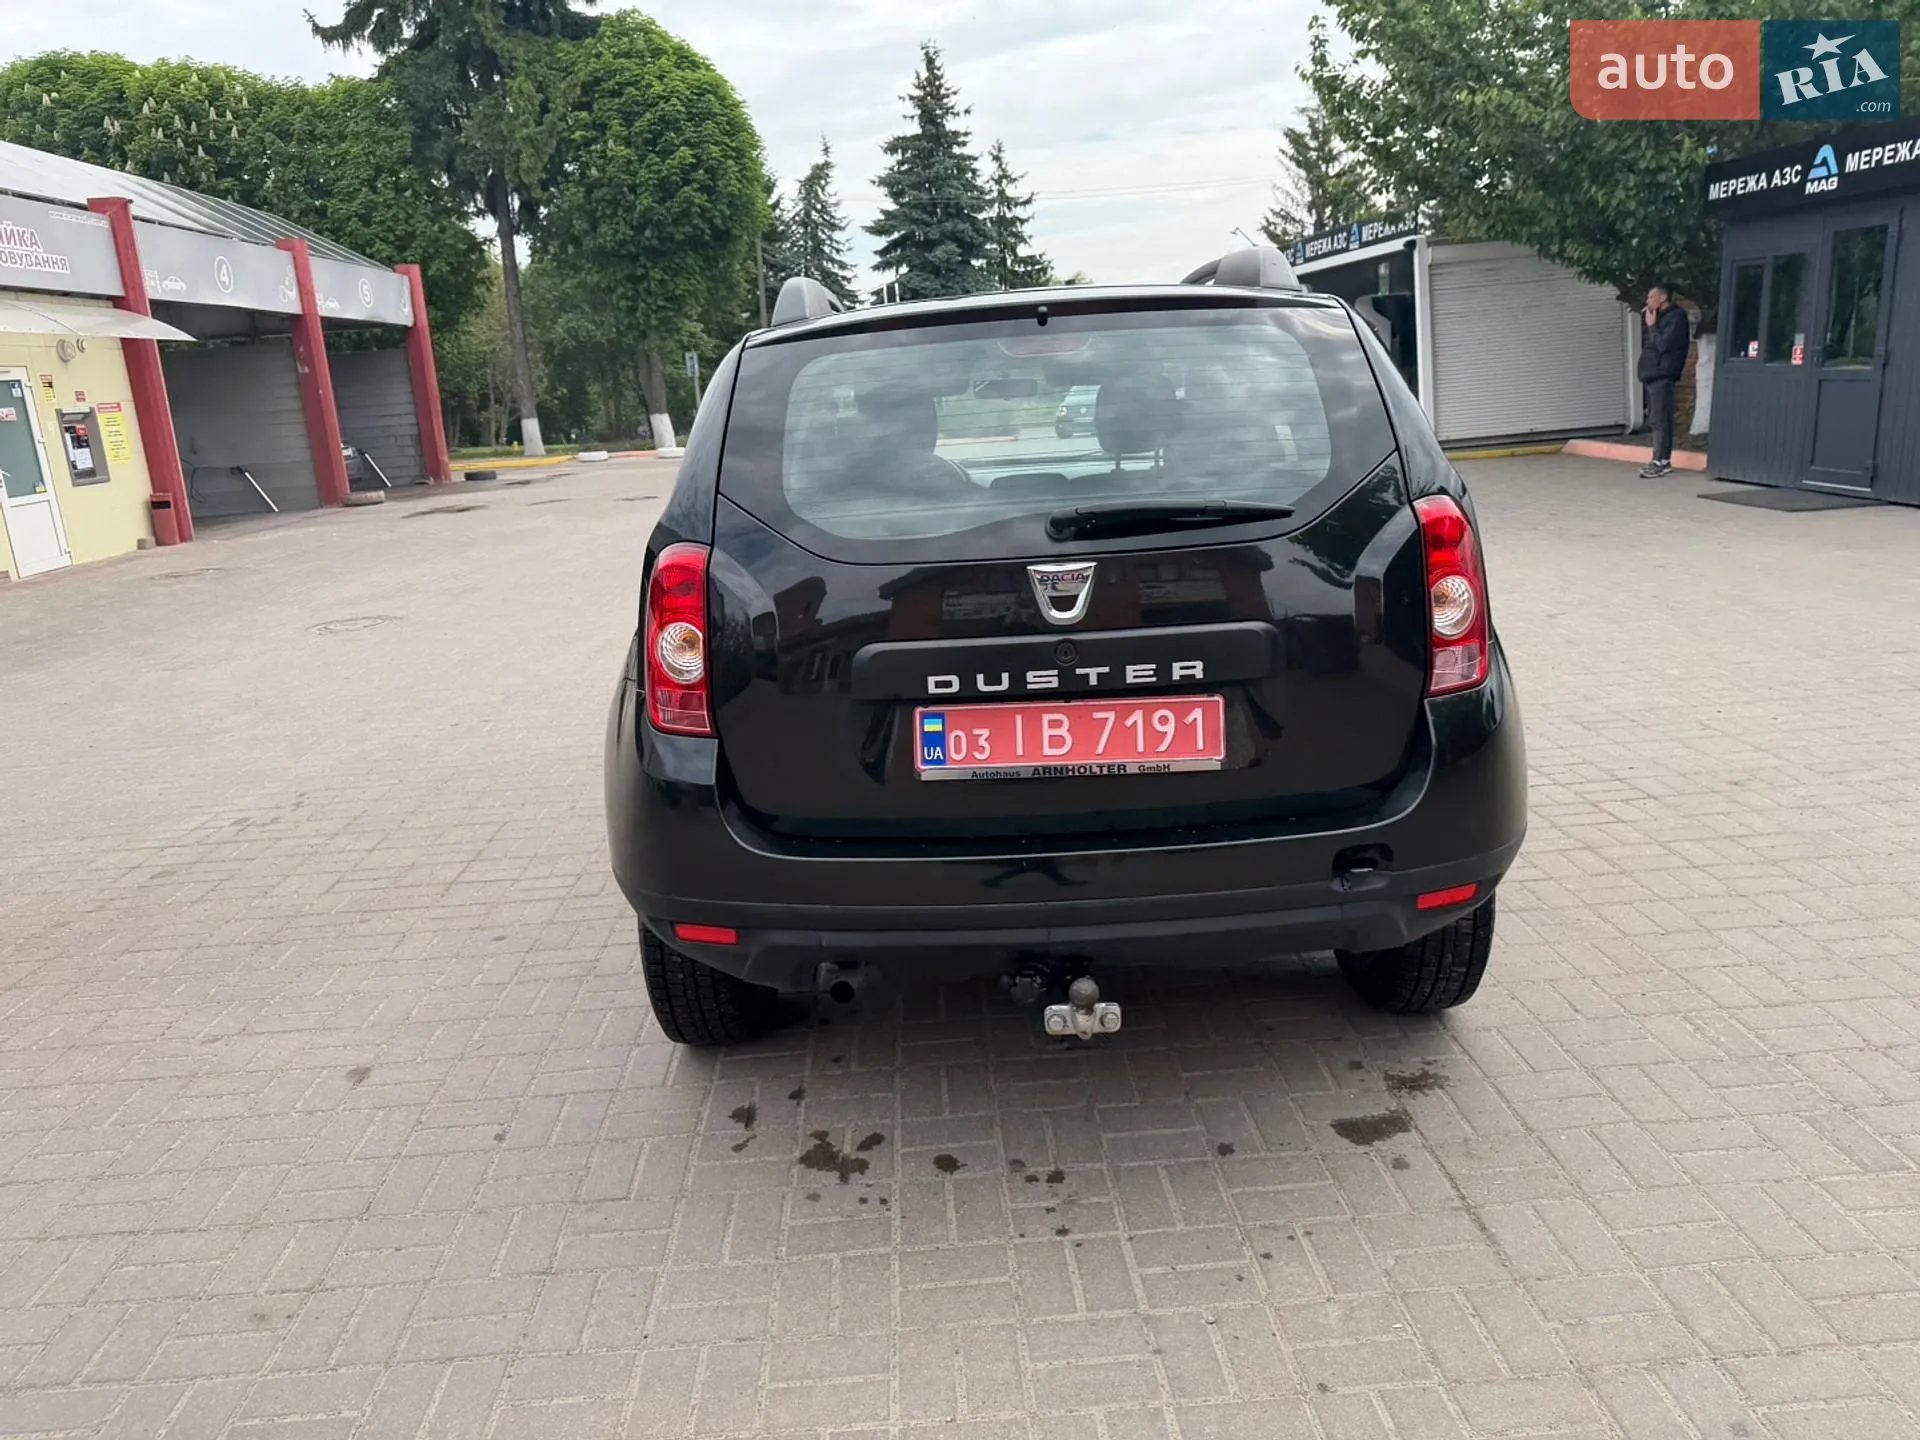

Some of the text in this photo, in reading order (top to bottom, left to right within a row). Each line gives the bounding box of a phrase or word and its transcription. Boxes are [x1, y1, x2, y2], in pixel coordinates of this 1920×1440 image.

[1844, 138, 1920, 173] МЕРЕЖА
[1708, 164, 1802, 201] МЕРЕЖА АЗС
[1305, 236, 1332, 258] МЕРЕЖА
[1333, 231, 1348, 251] АЗС
[219, 266, 229, 286] 4
[927, 661, 1206, 694] DUSTER
[950, 728, 991, 761] 03
[1091, 707, 1206, 755] 7191
[924, 747, 943, 760] UA
[971, 764, 1171, 779] Autohaus ARNHOLTER GmbH
